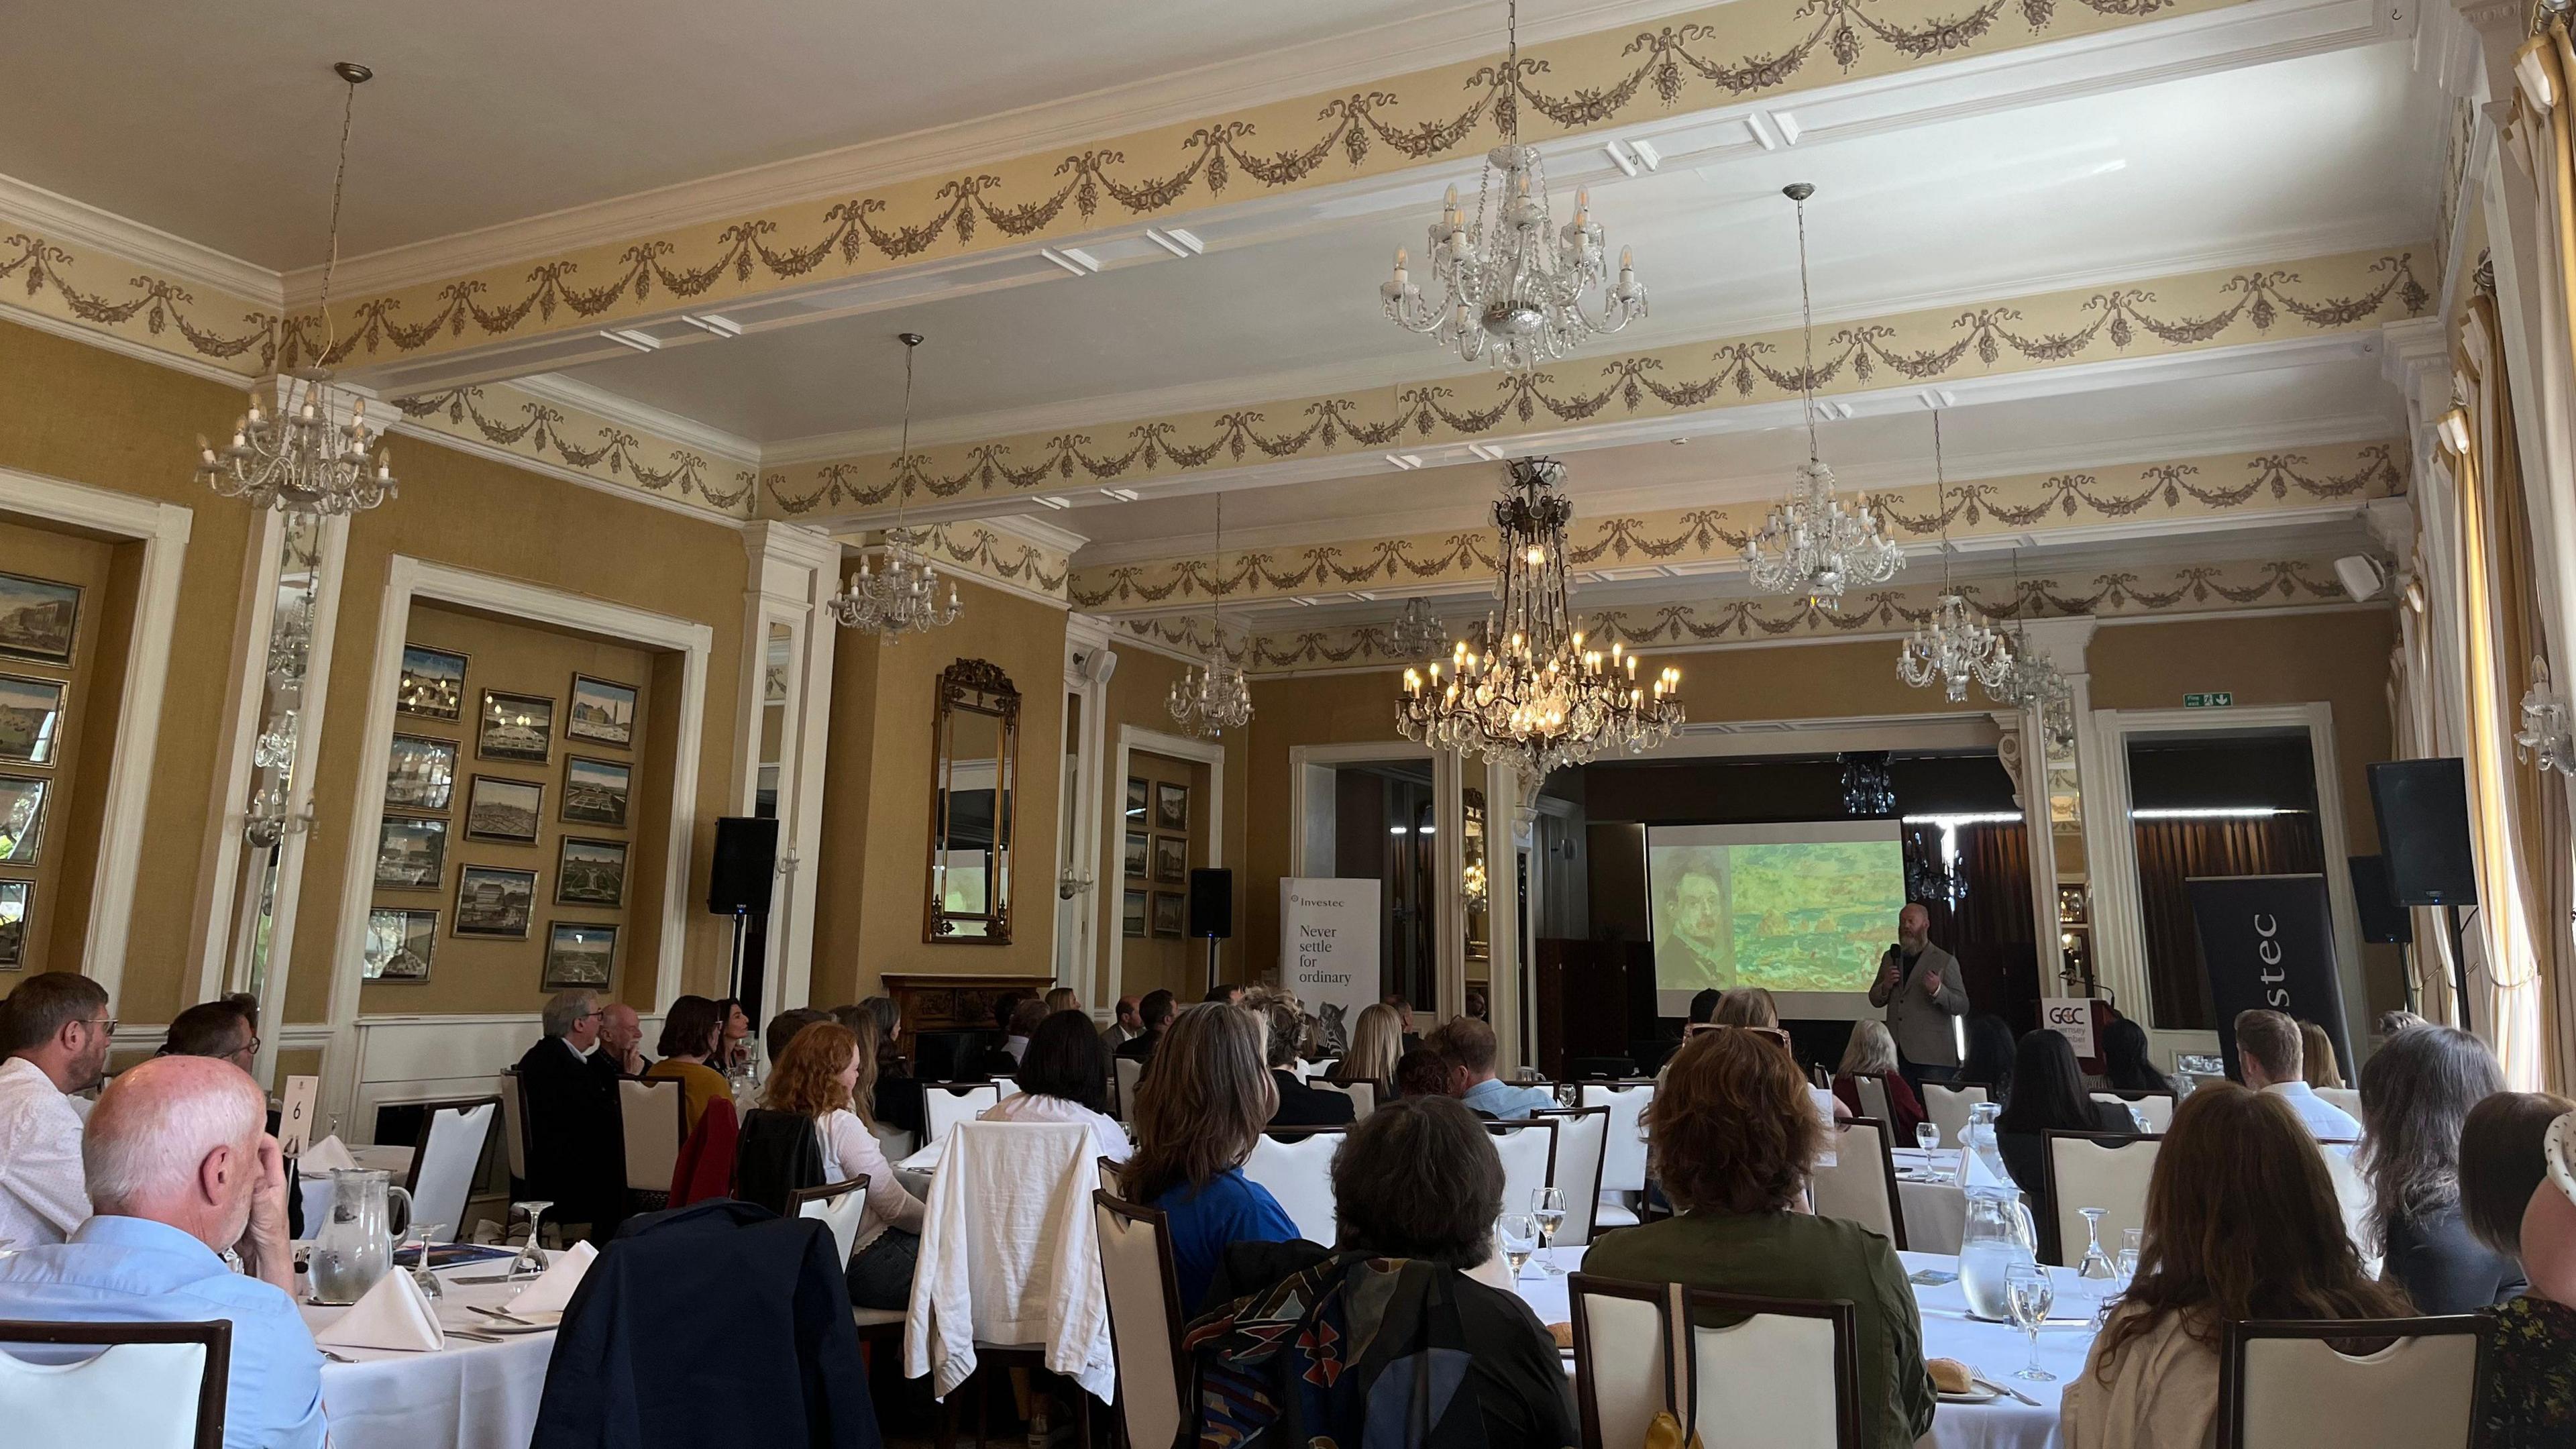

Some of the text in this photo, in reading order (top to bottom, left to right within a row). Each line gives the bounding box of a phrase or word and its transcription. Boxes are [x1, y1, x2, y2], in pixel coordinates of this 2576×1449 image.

[1301, 898, 1344, 907] Investec
[1300, 925, 1337, 937] Never
[1299, 940, 1332, 952] settle
[1299, 955, 1317, 967] for
[1299, 970, 1351, 986] ordinary
[293, 1101, 301, 1120] 6
